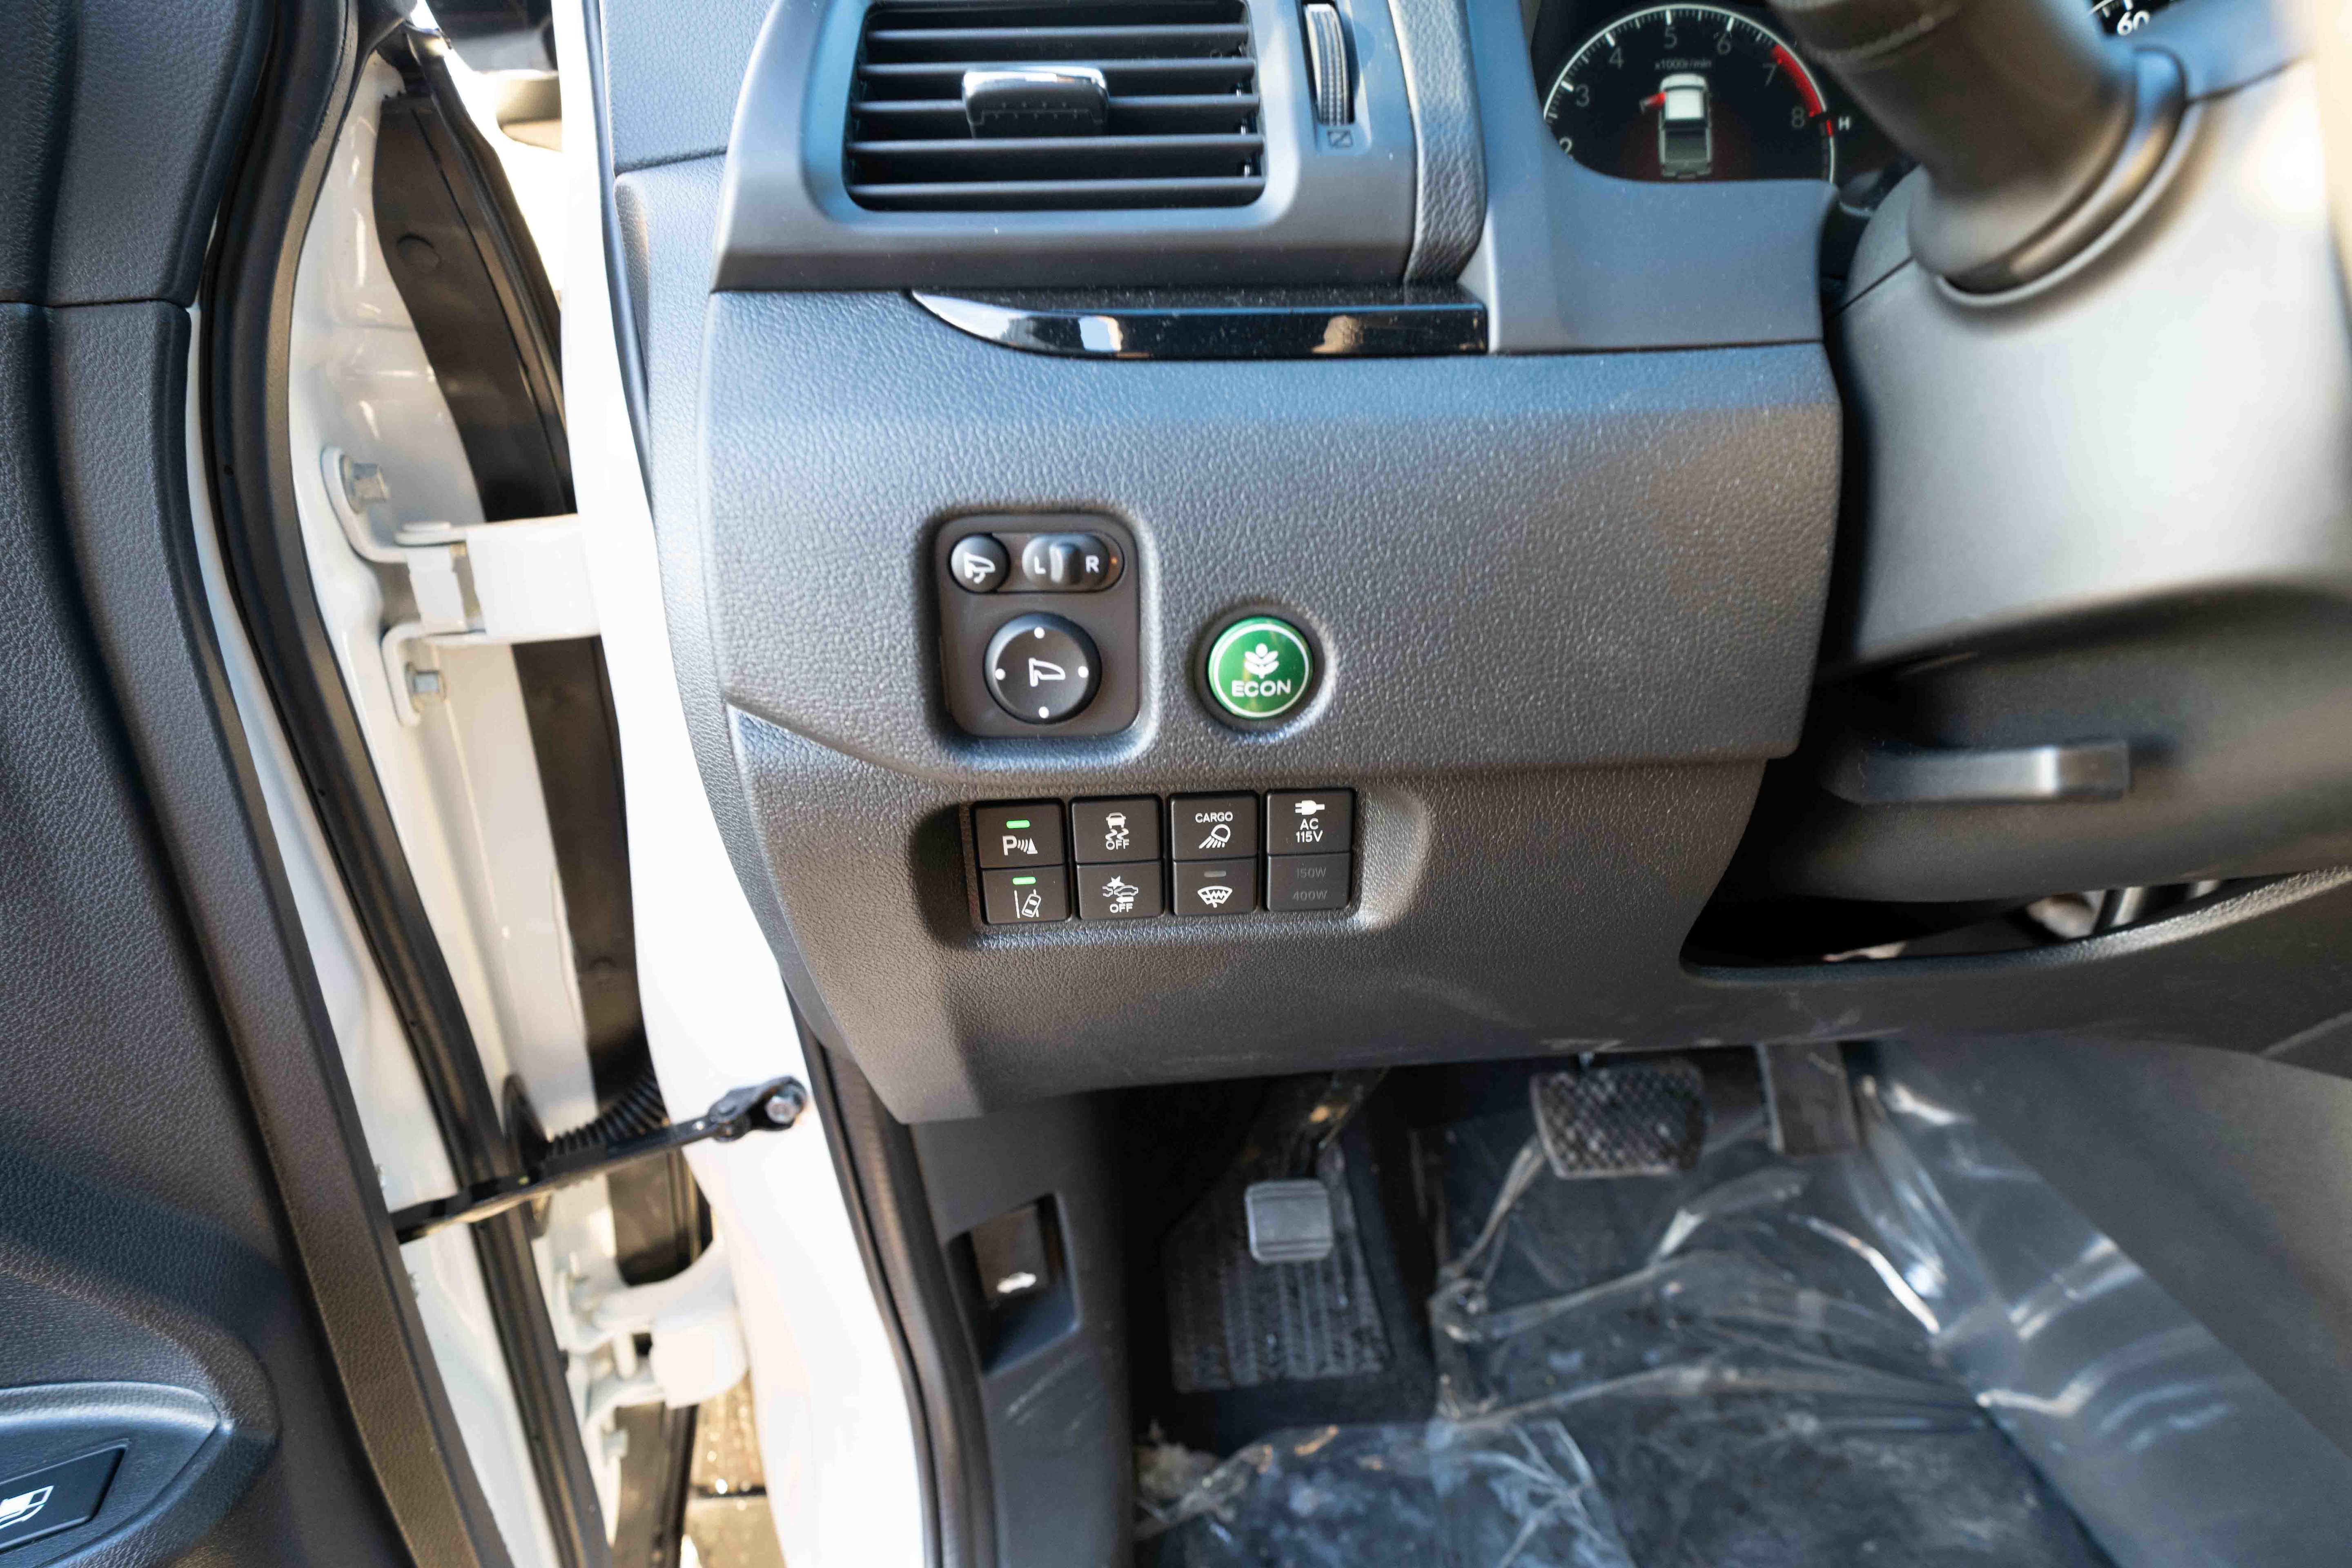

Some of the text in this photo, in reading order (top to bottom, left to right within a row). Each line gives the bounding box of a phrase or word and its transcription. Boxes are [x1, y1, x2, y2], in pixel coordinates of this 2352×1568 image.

[1664, 26, 1677, 49] 5
[1717, 30, 1731, 55] 6
[1608, 47, 1624, 69] 4
[1763, 62, 1777, 86] 7
[1576, 84, 1589, 107] 3
[1791, 106, 1806, 128] 8
[1839, 116, 1851, 130] H
[1034, 556, 1046, 574] L
[1086, 555, 1099, 572] R
[1231, 679, 1291, 697] ECON
[1195, 811, 1233, 823] CARGO
[1300, 818, 1319, 830] AC
[1106, 839, 1129, 850] OFF
[1296, 830, 1323, 843] 115V
[1002, 836, 1017, 855] P
[1296, 866, 1327, 879] 150W
[1292, 888, 1328, 901] 400W
[1110, 903, 1133, 913] OFF
